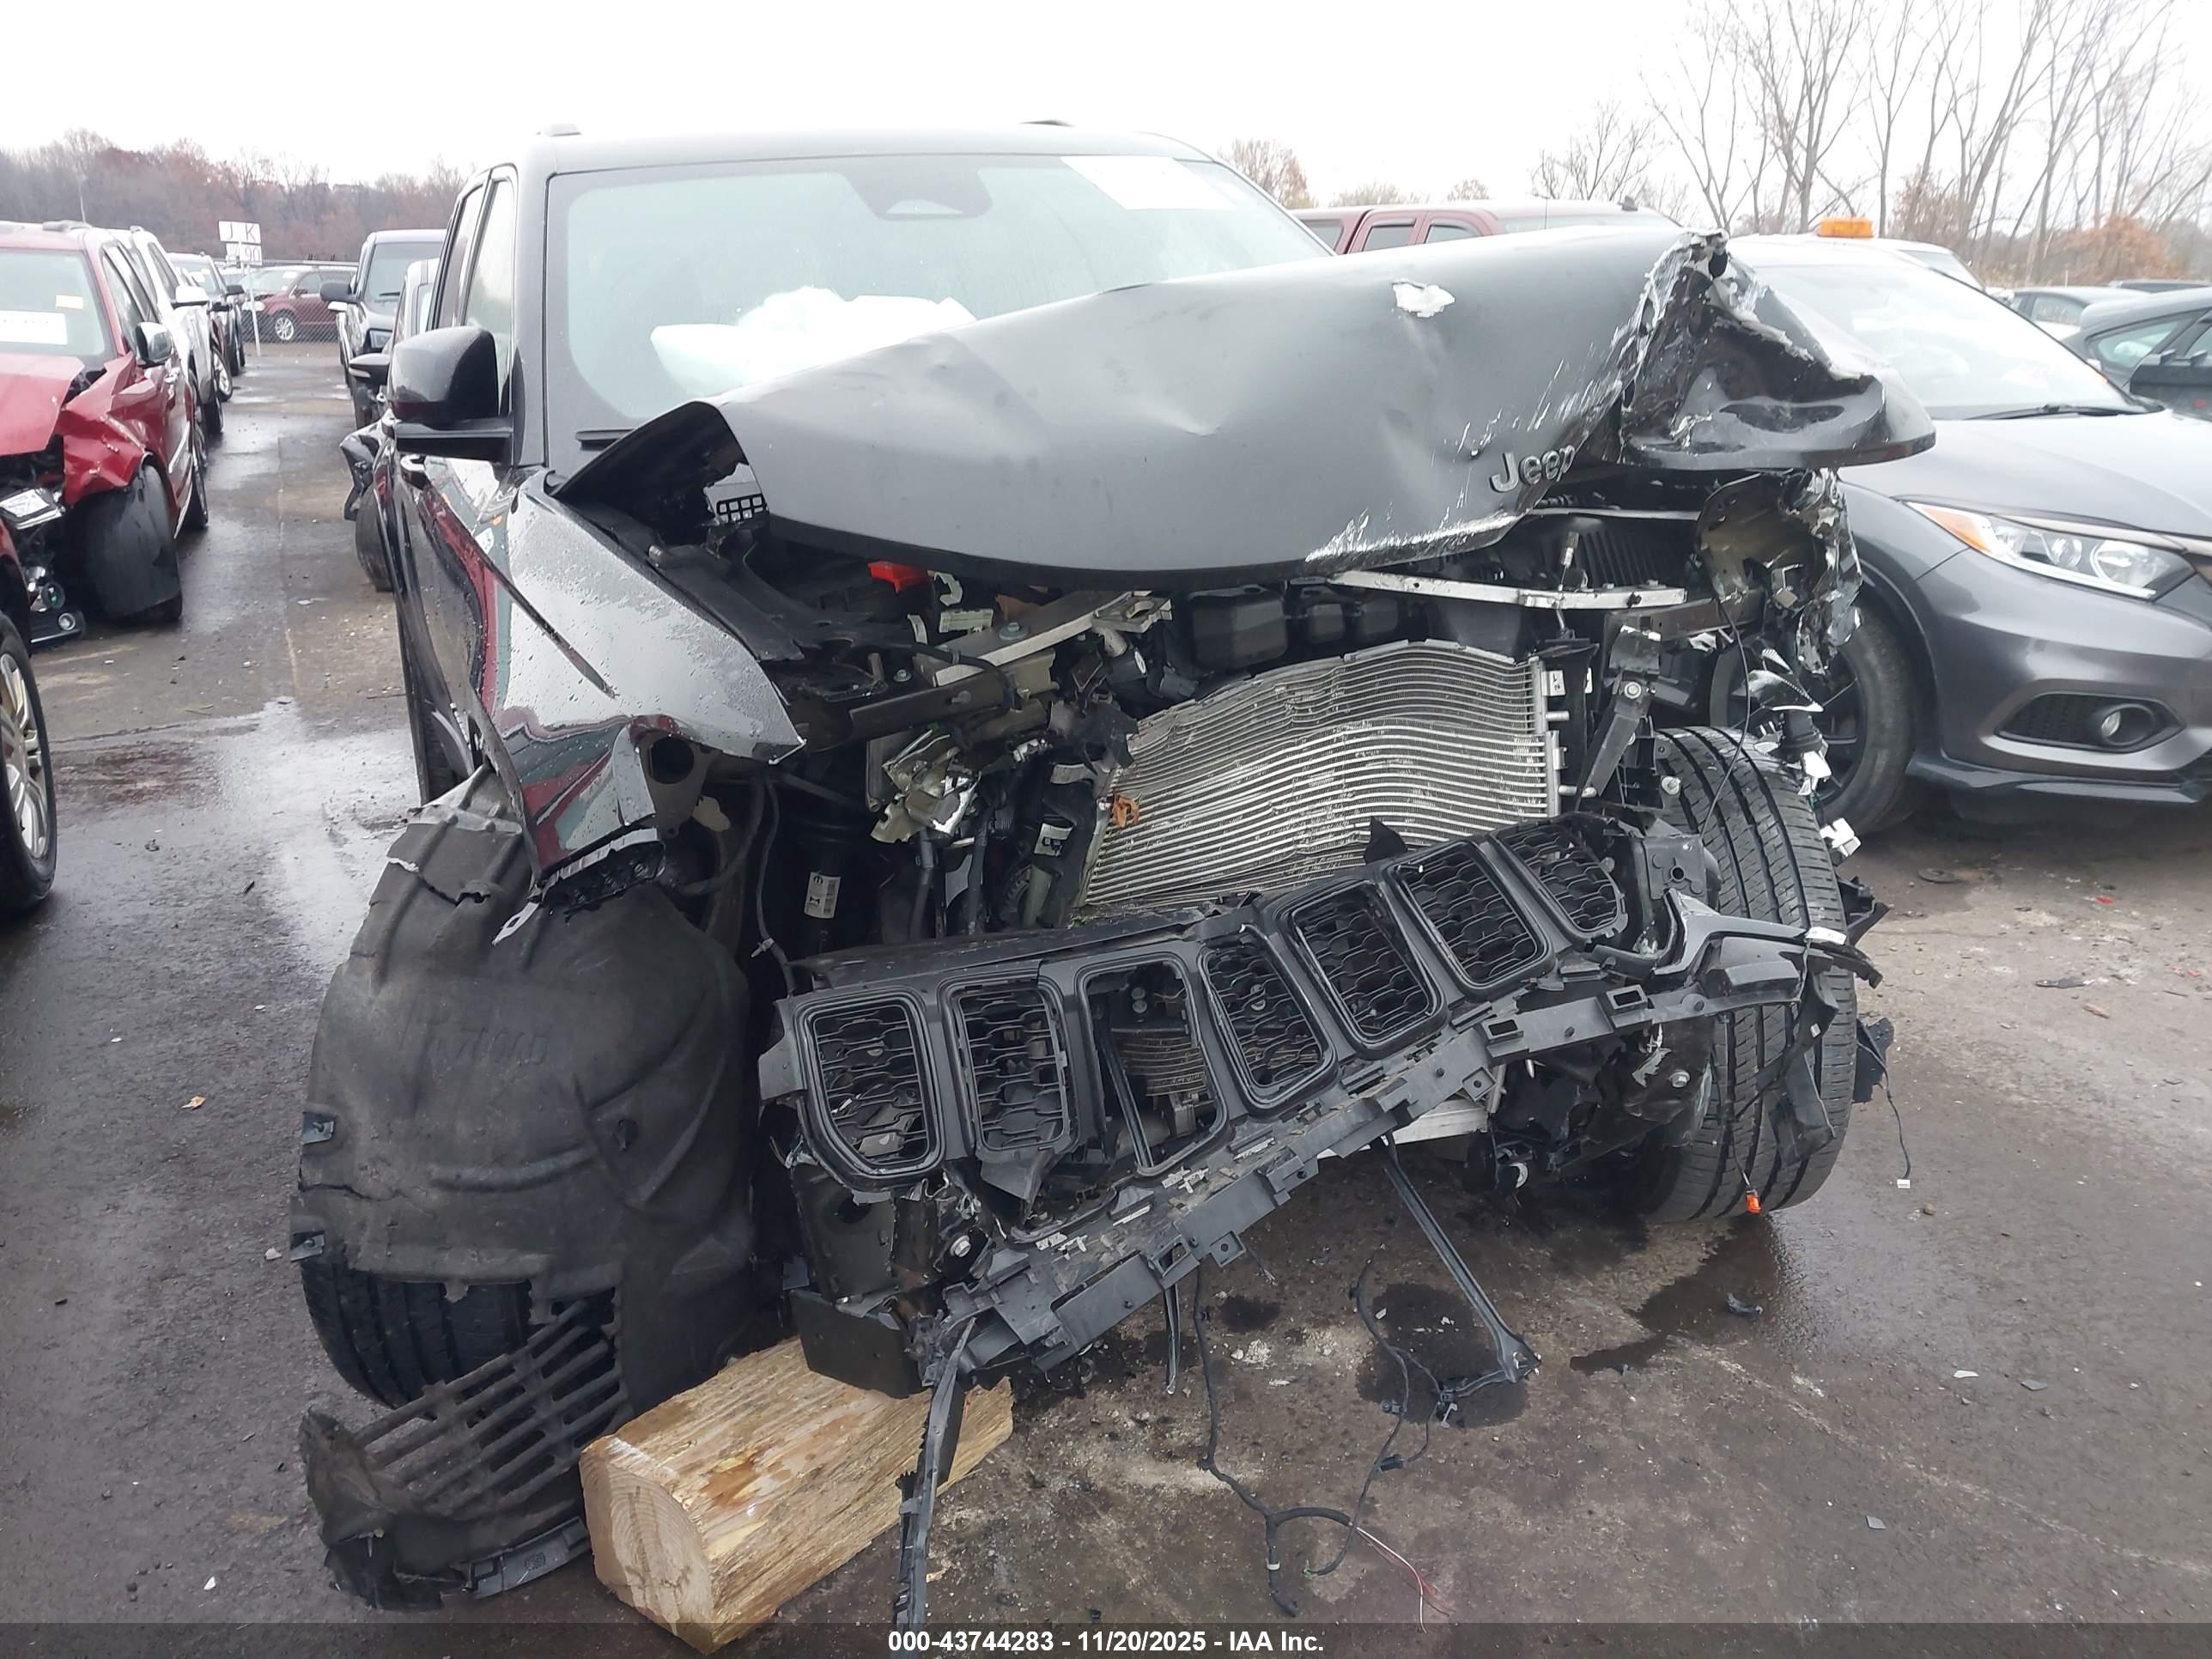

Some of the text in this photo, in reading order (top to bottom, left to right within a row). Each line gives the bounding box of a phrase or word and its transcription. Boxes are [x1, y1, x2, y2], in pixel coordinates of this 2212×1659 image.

[227, 222, 257, 243] J K
[1490, 445, 1575, 493] Jeep
